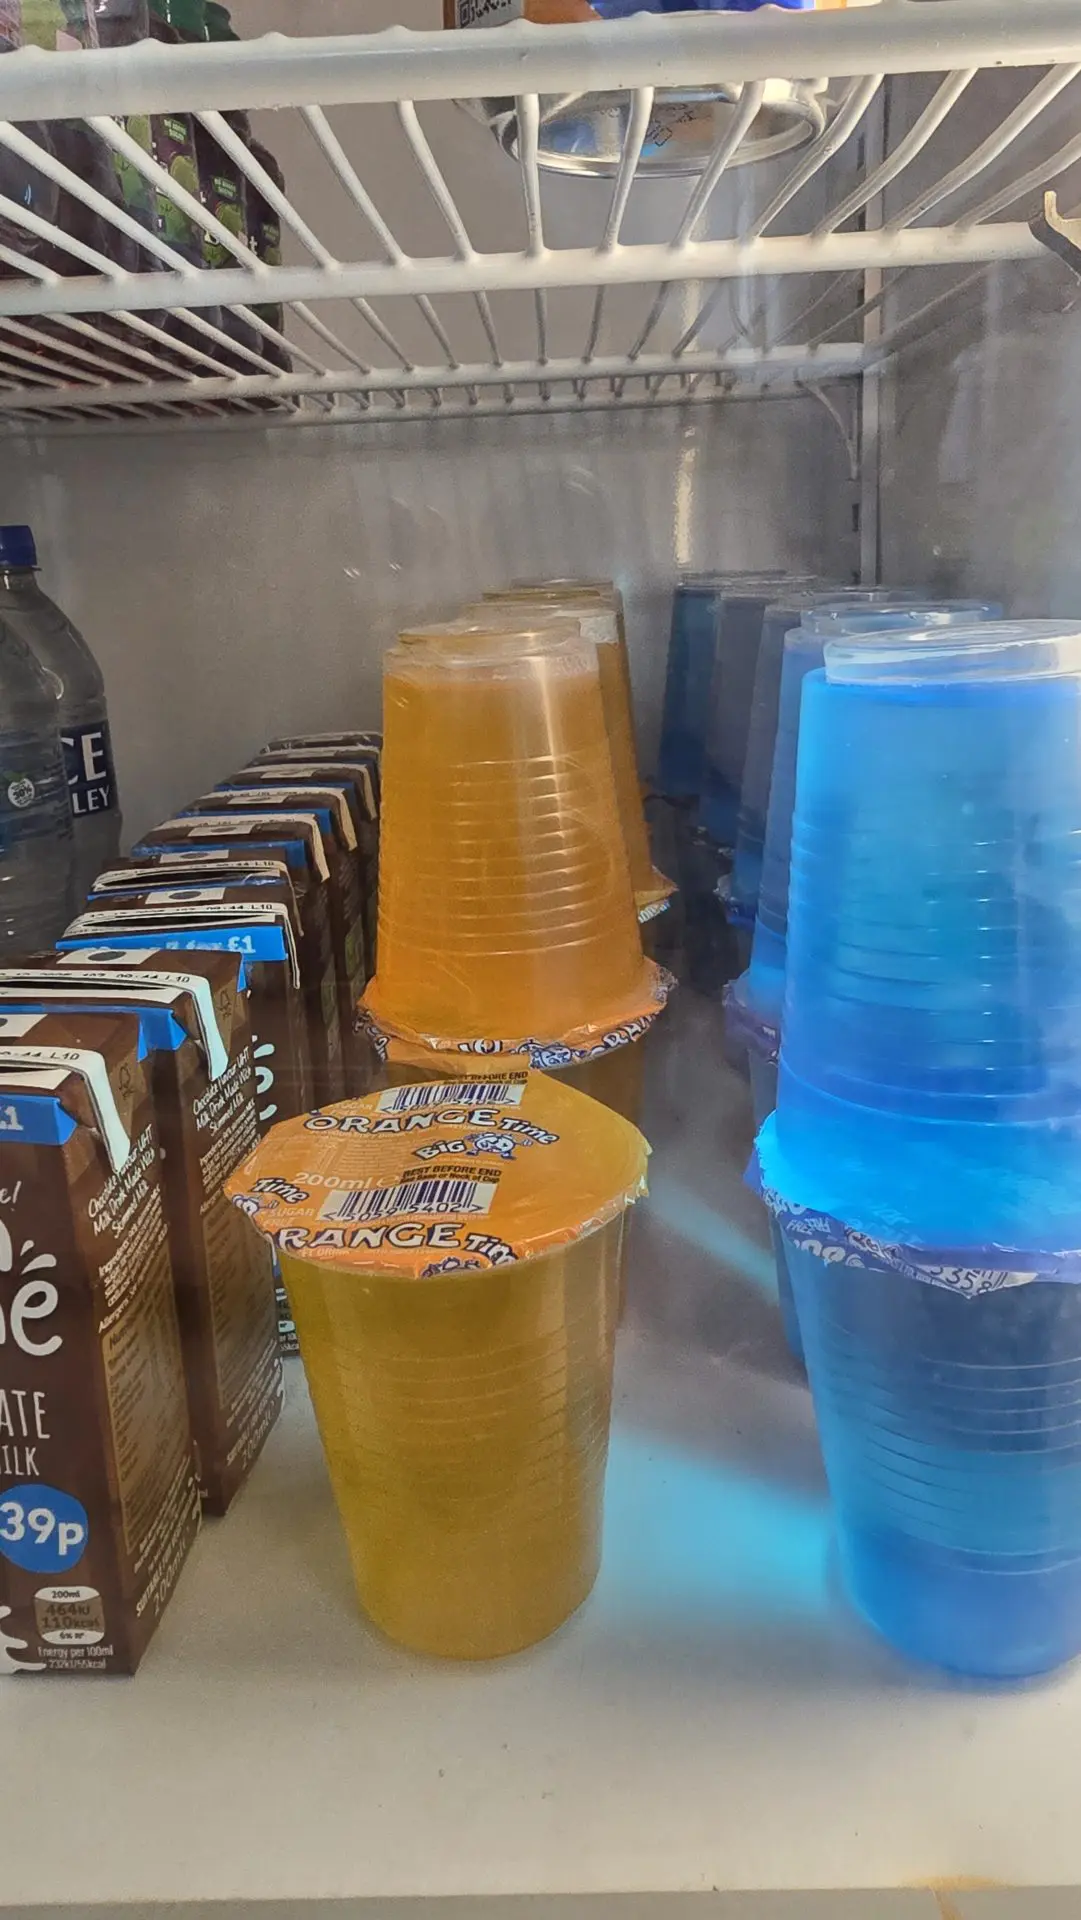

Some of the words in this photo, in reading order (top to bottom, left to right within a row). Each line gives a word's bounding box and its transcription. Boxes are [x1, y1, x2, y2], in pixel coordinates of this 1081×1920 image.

[303, 1108, 499, 1134] ORANGE
[501, 1117, 559, 1145] Time
[292, 1172, 373, 1189] 200ml
[403, 1167, 431, 1179] BEST
[433, 1165, 476, 1175] BEFORE
[478, 1168, 503, 1178] END
[250, 1178, 309, 1204] Time
[266, 1222, 465, 1251] RANGE
[0, 1502, 84, 1556] 39p
[51, 1590, 80, 1599] 200ml
